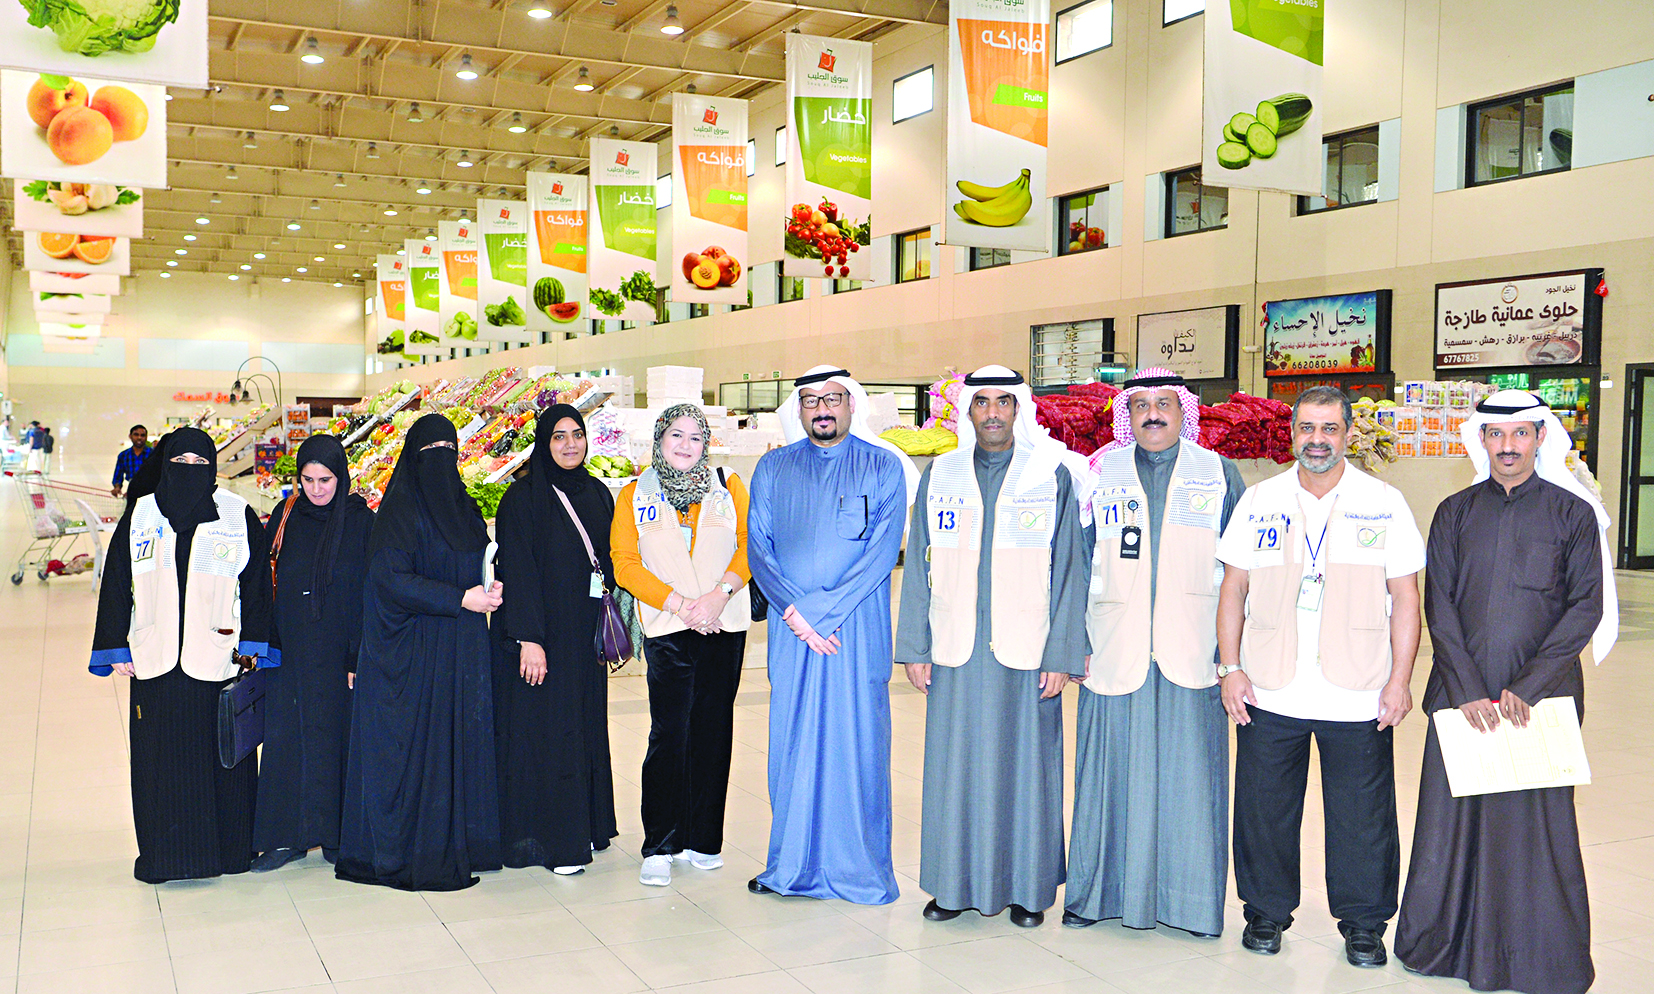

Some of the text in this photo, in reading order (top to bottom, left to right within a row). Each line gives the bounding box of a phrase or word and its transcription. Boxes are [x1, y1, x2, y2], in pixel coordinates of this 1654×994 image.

[982, 30, 1044, 56] فواكه
[1024, 92, 1044, 102] Fruits
[697, 152, 744, 168] فواكه
[830, 153, 868, 163] Vegetables
[618, 191, 654, 206] خضار
[546, 214, 584, 228] فواكه
[1328, 307, 1366, 336] نخيل
[1444, 302, 1578, 330] حلوى عمانية طازجة
[1292, 360, 1338, 370] 66208039
[1444, 354, 1479, 364] 67767825
[638, 505, 656, 522] 70
[938, 510, 956, 530] 13
[1102, 504, 1118, 525] 71
[1257, 527, 1278, 548] 79
[136, 540, 150, 560] 77
